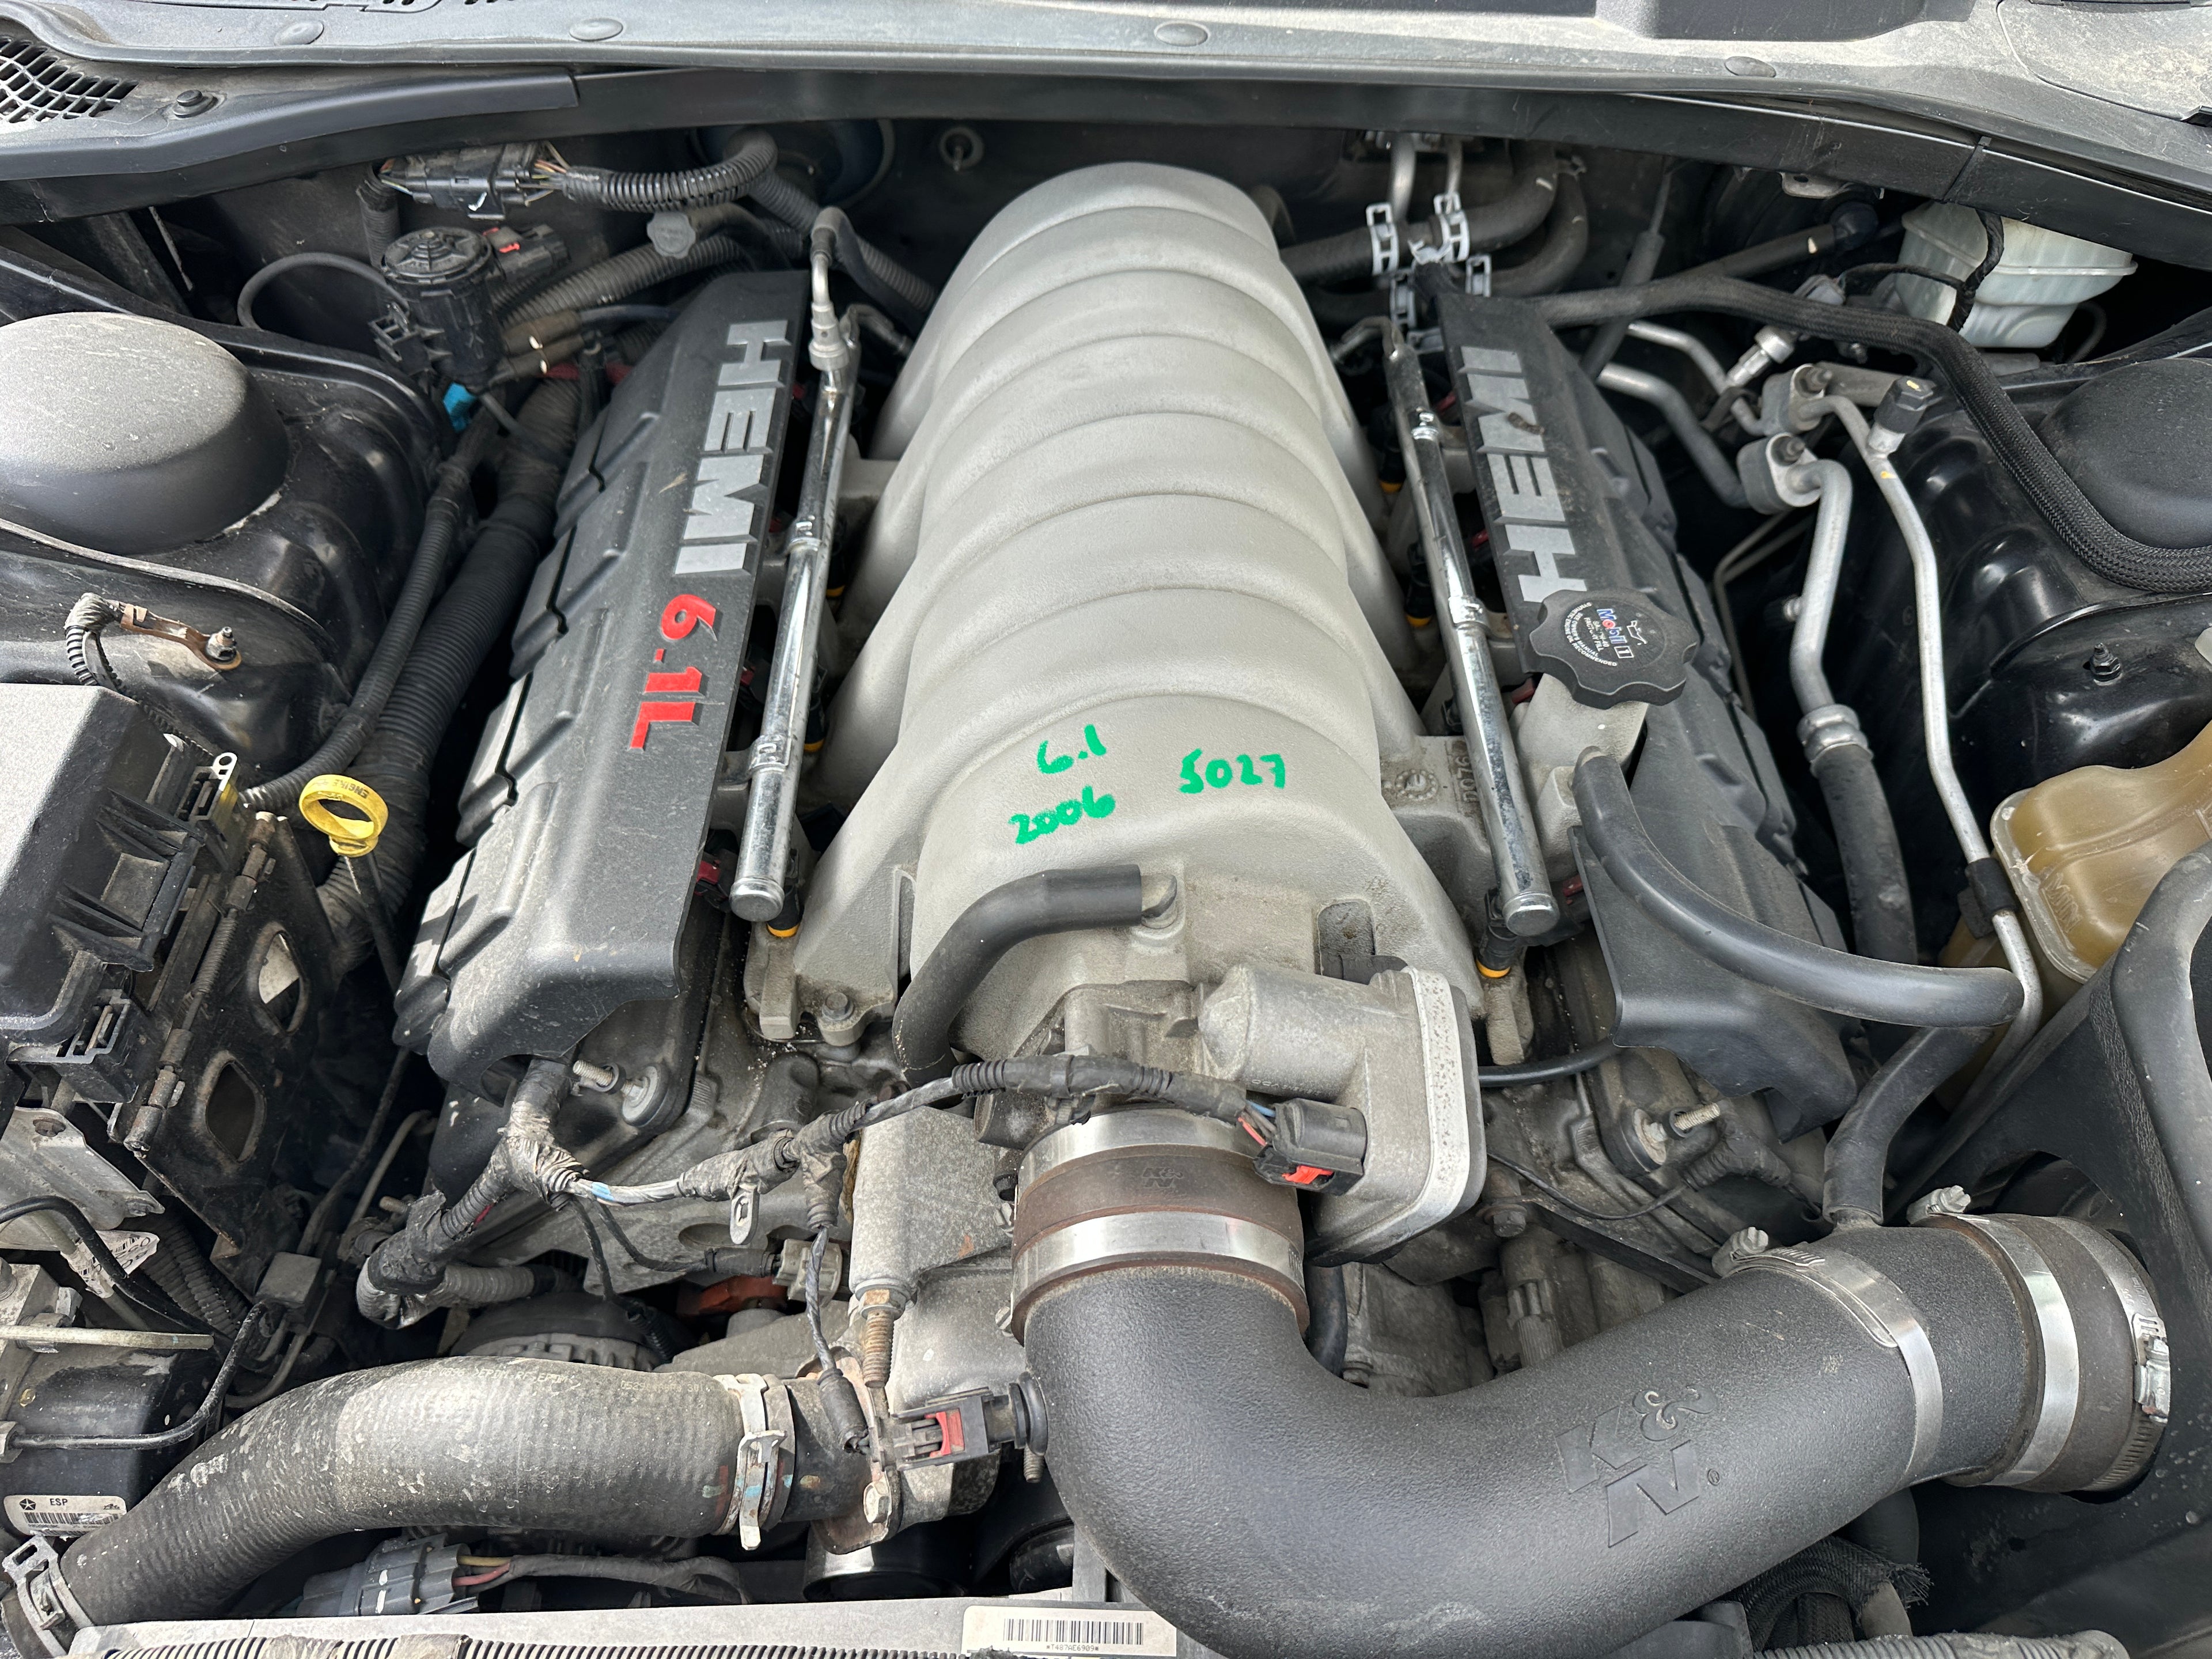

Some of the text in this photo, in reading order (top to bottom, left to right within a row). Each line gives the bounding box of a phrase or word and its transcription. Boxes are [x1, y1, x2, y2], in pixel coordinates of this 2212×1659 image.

[675, 319, 788, 575] HEMI
[1460, 346, 1588, 603] HEMI
[1564, 618, 1572, 635] ENGINE
[1567, 602, 1592, 619] SYNTHETIC
[1596, 608, 1628, 645] Mobil
[1571, 642, 1618, 666] RECOMMENDED
[1577, 640, 1599, 657] MANUAL
[1593, 640, 1604, 652] FILL
[630, 593, 717, 749] 6.1L
[1037, 724, 1107, 774] 6.1
[1177, 748, 1286, 794] 5027
[1008, 785, 1116, 844] 2006
[49, 1498, 68, 1506] ESP
